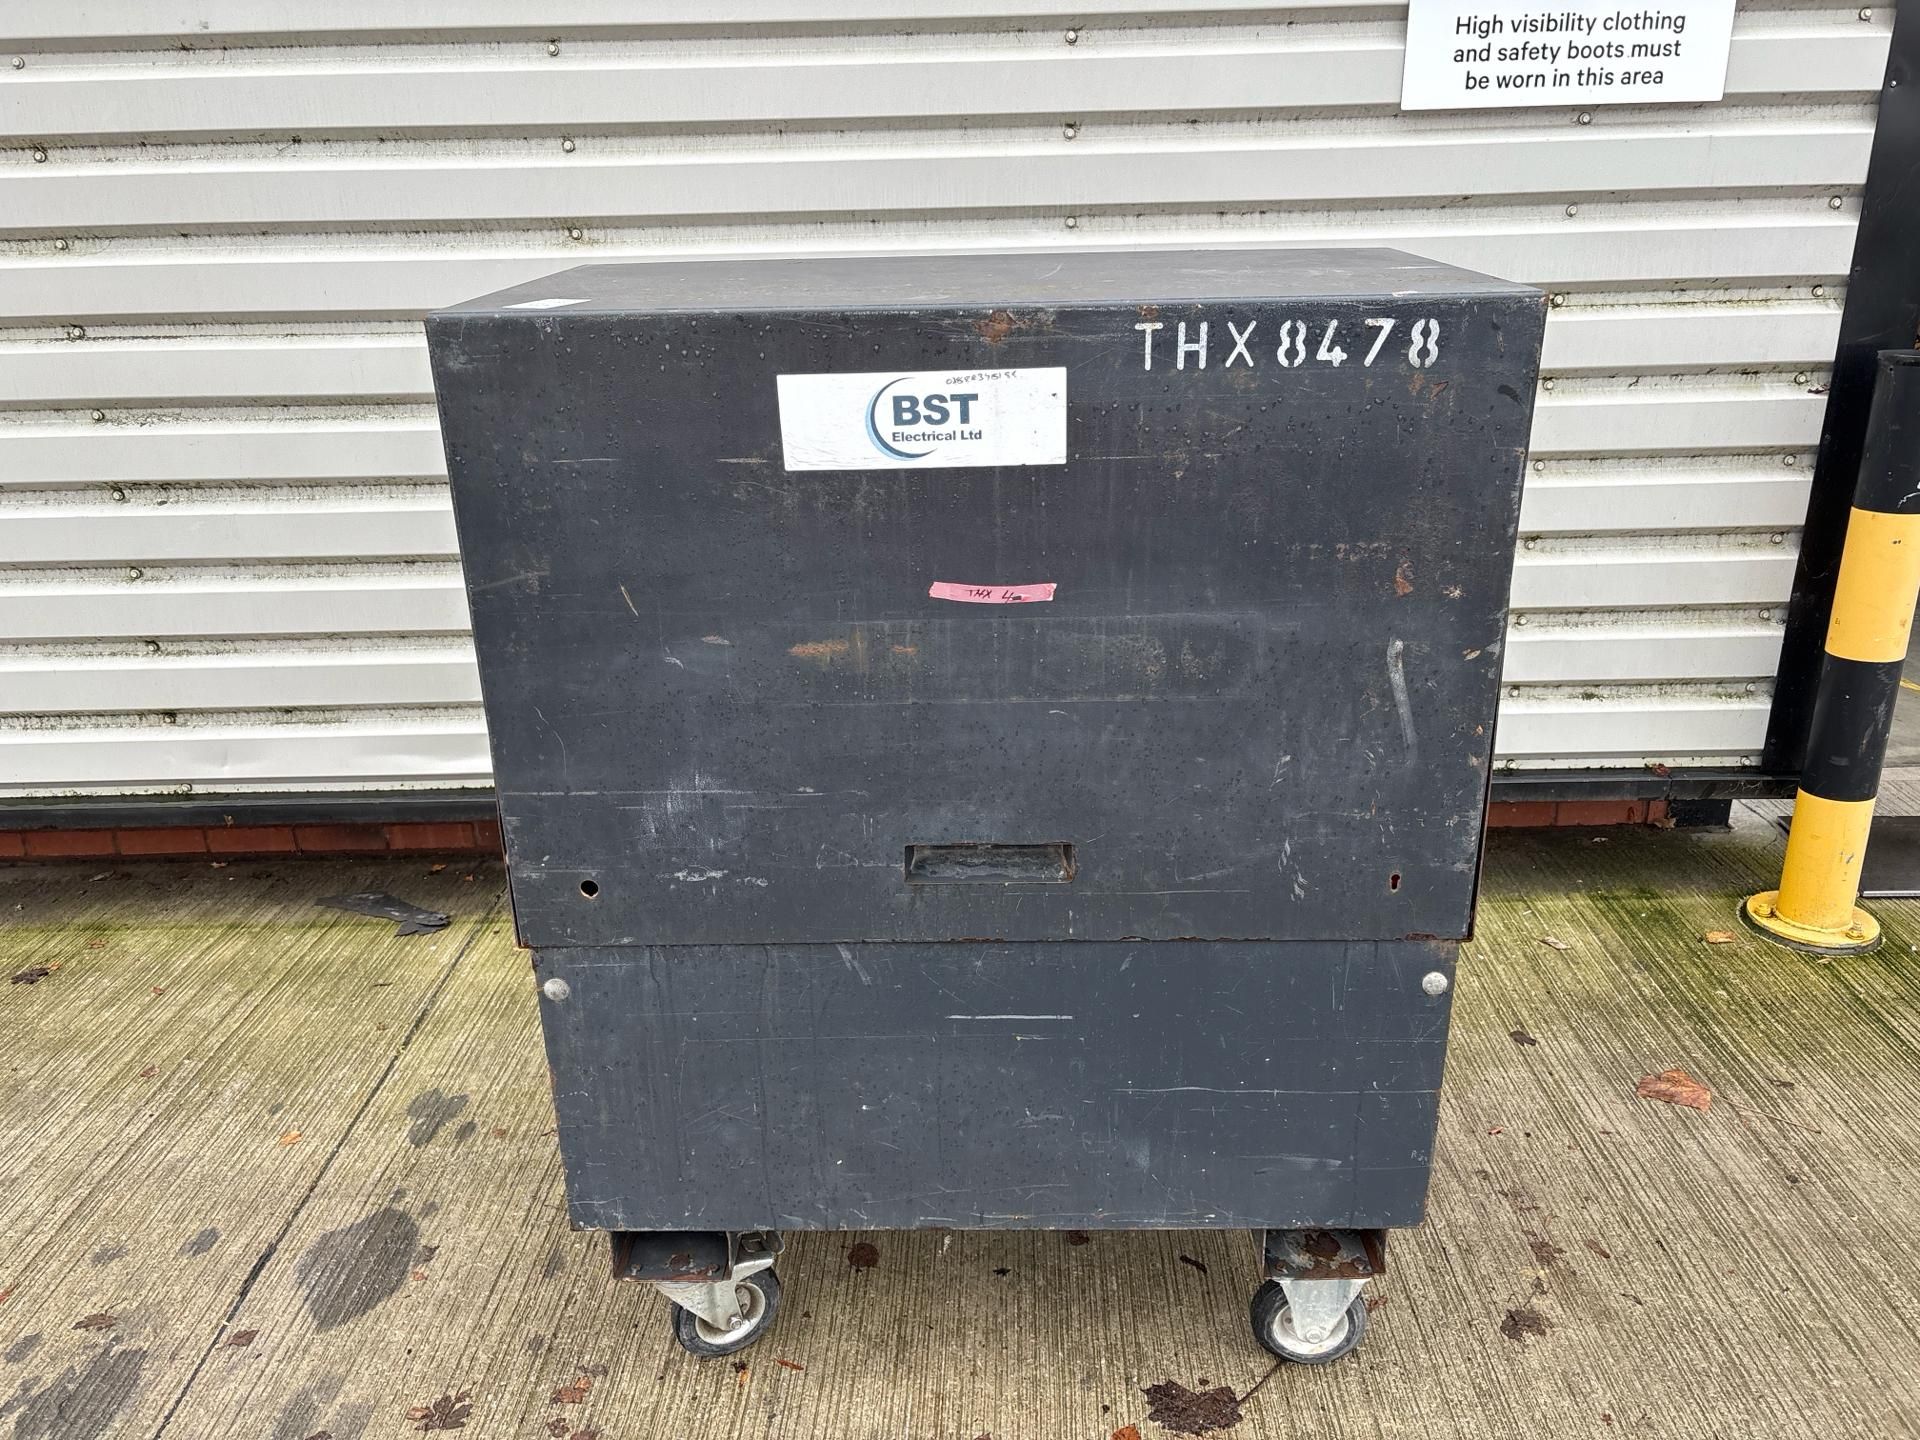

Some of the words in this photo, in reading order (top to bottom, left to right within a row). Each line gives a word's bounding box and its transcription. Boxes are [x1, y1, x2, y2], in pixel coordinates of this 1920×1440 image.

[1455, 15, 1504, 39] High
[1510, 13, 1597, 36] visibility
[1602, 10, 1687, 34] clothing
[1453, 43, 1491, 63] and
[1497, 41, 1562, 65] safety
[1567, 40, 1625, 60] boots
[1630, 39, 1682, 59] must
[1465, 70, 1490, 91] be
[1496, 72, 1546, 89] worn
[1552, 68, 1571, 88] in
[1577, 67, 1614, 87] this
[1620, 69, 1664, 86] area
[892, 393, 979, 426] BST
[891, 430, 957, 443] Electrical
[960, 429, 983, 441] Ltd
